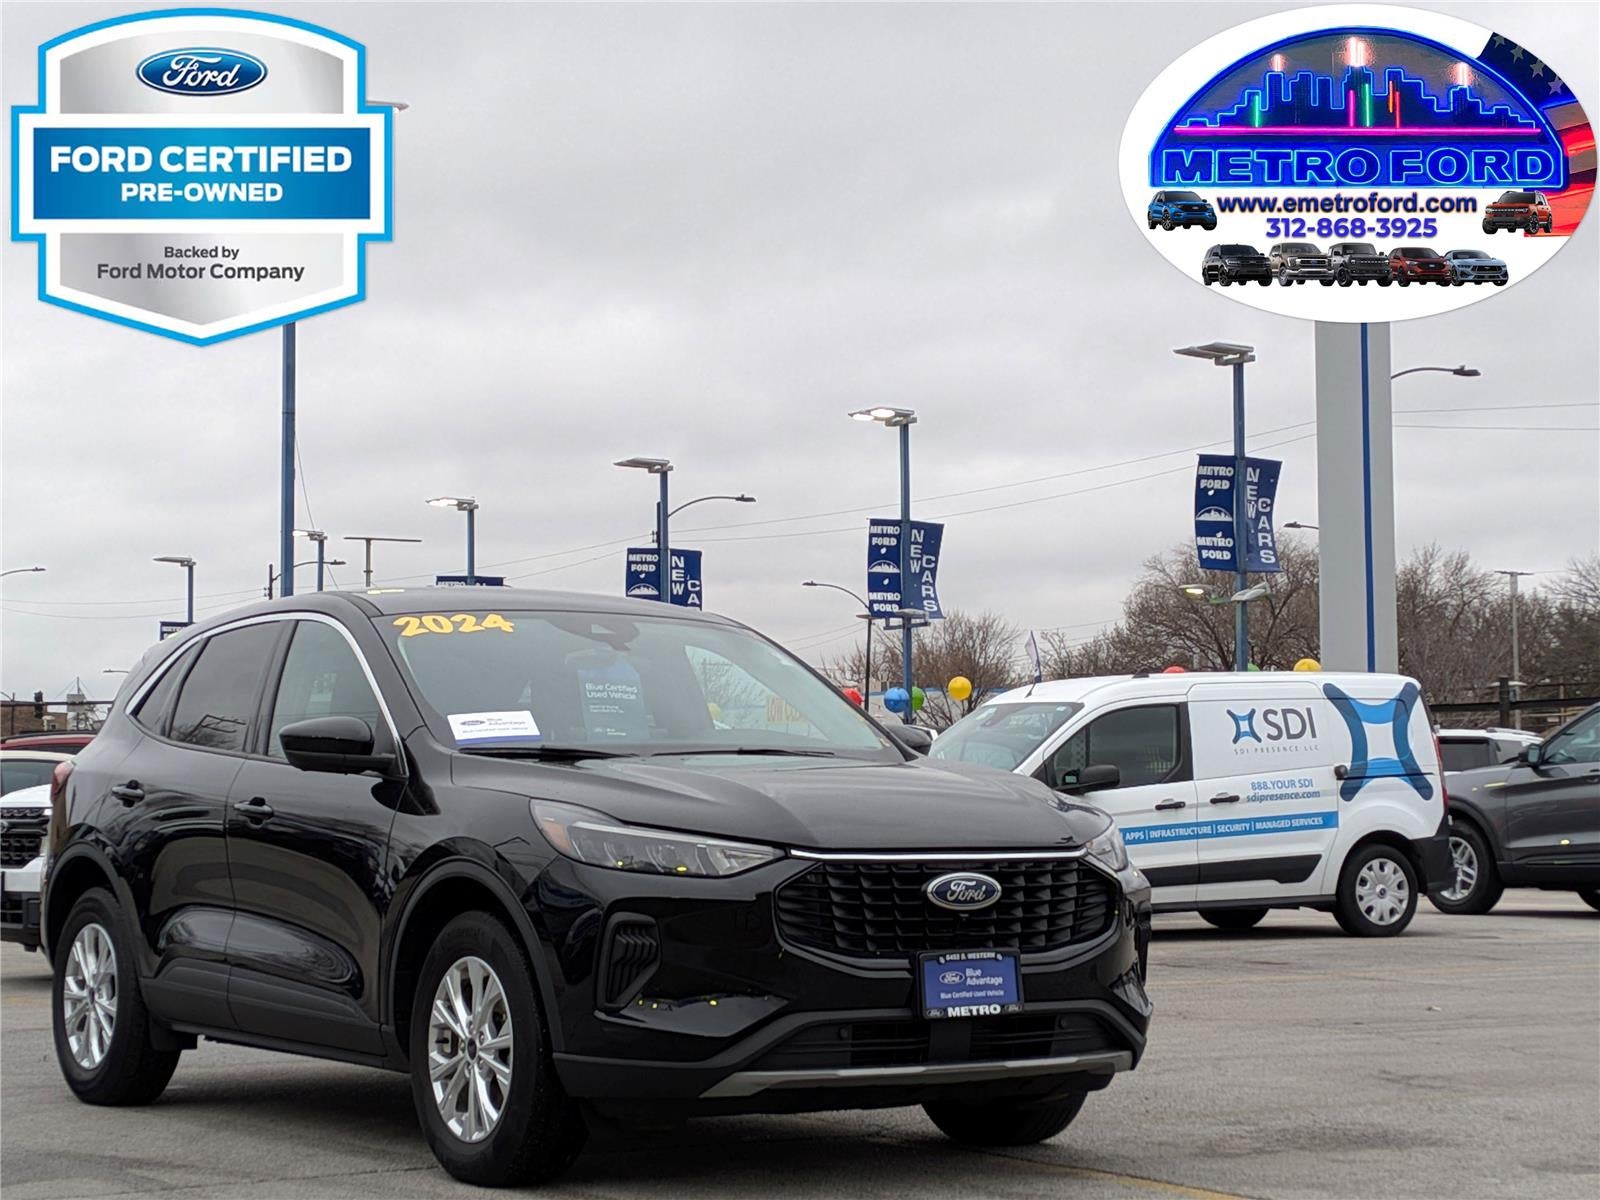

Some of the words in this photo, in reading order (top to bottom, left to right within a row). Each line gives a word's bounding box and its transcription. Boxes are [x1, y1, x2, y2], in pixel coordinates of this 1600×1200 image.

[1198, 466, 1234, 476] METRO
[1200, 479, 1230, 489] FORD
[1246, 467, 1260, 519] NEW
[870, 526, 900, 535] METRO
[1257, 498, 1276, 563] CARS
[872, 537, 897, 546] FORD
[1196, 536, 1234, 547] METRO
[910, 529, 924, 573] NEW
[1201, 550, 1231, 560] FORD
[628, 554, 659, 562] METRO
[631, 564, 656, 572] FORD
[671, 555, 685, 595] NEW
[921, 555, 938, 612] CARS
[868, 592, 901, 601] METRO
[873, 603, 899, 612] FORD
[393, 613, 515, 637] 2024
[1263, 707, 1317, 741] SDI
[1250, 780, 1297, 791] 888.YOUR
[1298, 778, 1313, 788] SDI
[1247, 790, 1320, 803] sdipresence.com
[1125, 831, 1144, 841] APPS
[1149, 825, 1212, 838] INFRASTRUCTURE
[1217, 823, 1250, 833] SECURITY
[1255, 819, 1291, 829] MANAGED
[1291, 817, 1323, 827] SERVICES
[947, 879, 986, 901] Ford
[947, 1004, 1001, 1017] METRO
